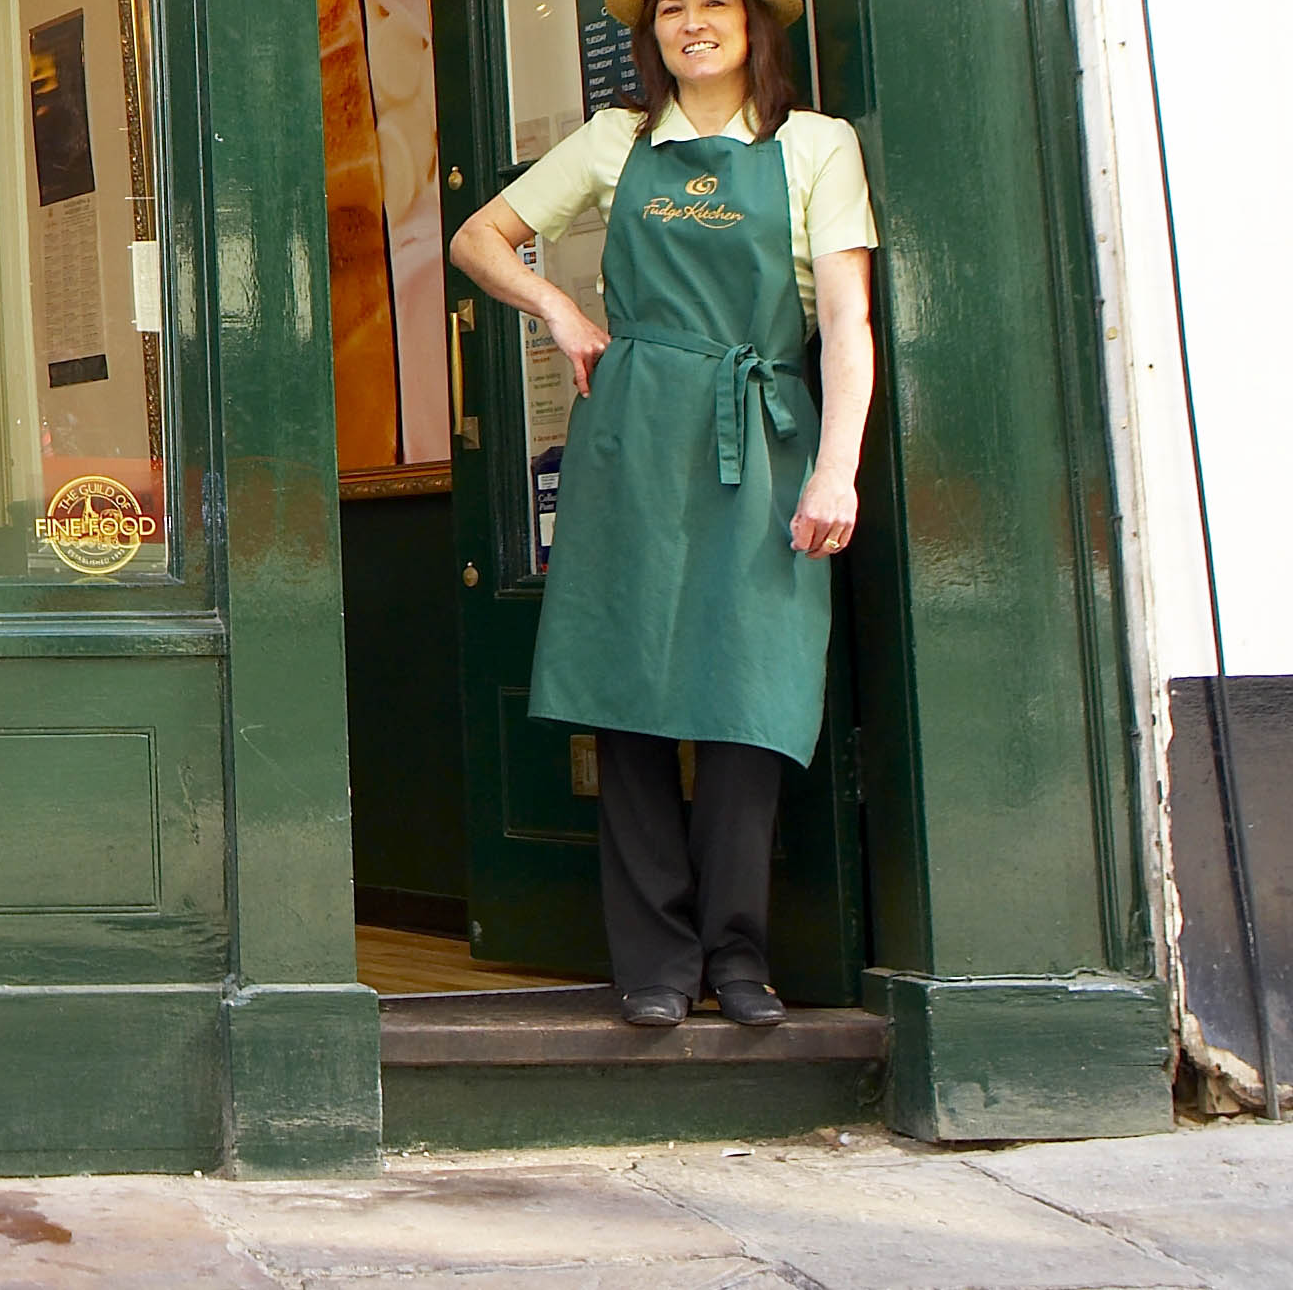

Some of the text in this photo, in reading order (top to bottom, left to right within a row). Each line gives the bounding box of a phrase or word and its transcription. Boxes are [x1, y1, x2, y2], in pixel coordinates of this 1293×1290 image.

[642, 197, 745, 229] Fudge Kitchen
[58, 482, 132, 512] THE GUILD OF
[35, 516, 157, 539] FINE FOOD
